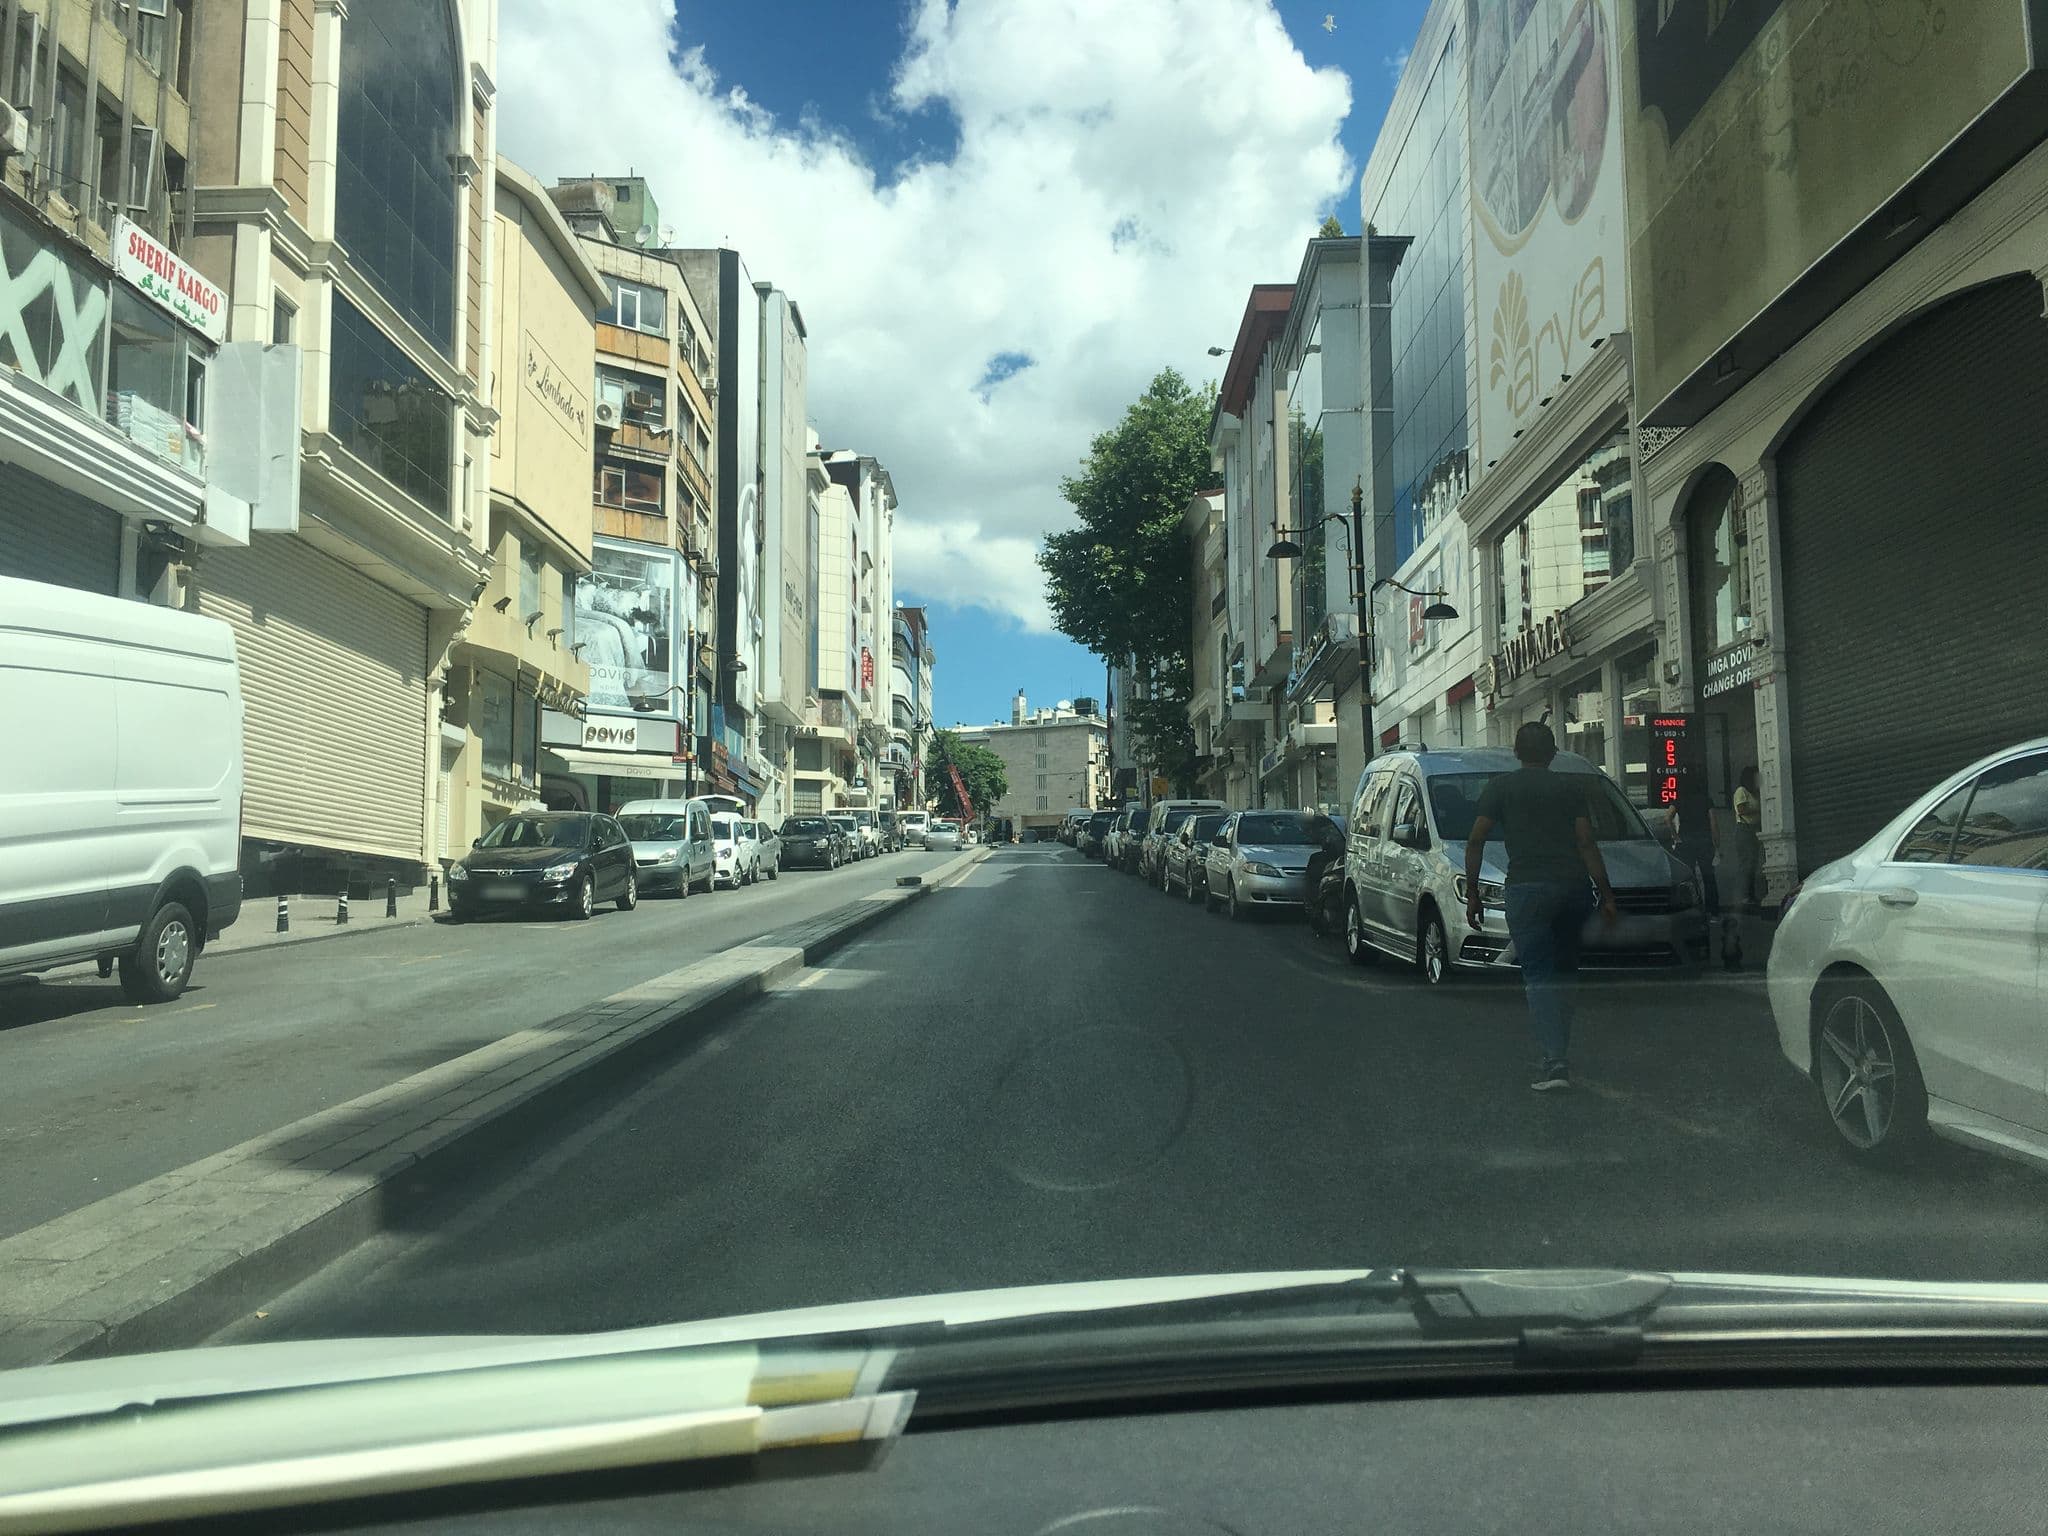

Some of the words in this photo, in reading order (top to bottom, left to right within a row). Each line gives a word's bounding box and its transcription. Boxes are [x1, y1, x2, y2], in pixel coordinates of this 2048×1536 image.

[128, 231, 177, 283] SHERİF
[176, 266, 218, 315] KARGO
[1514, 255, 1605, 419] arya
[1707, 656, 1729, 677] İMGA
[1730, 641, 1752, 668] DÖVİ
[1703, 674, 1735, 698] CHANGE
[1736, 667, 1752, 685] OFF
[626, 767, 651, 776] pavia
